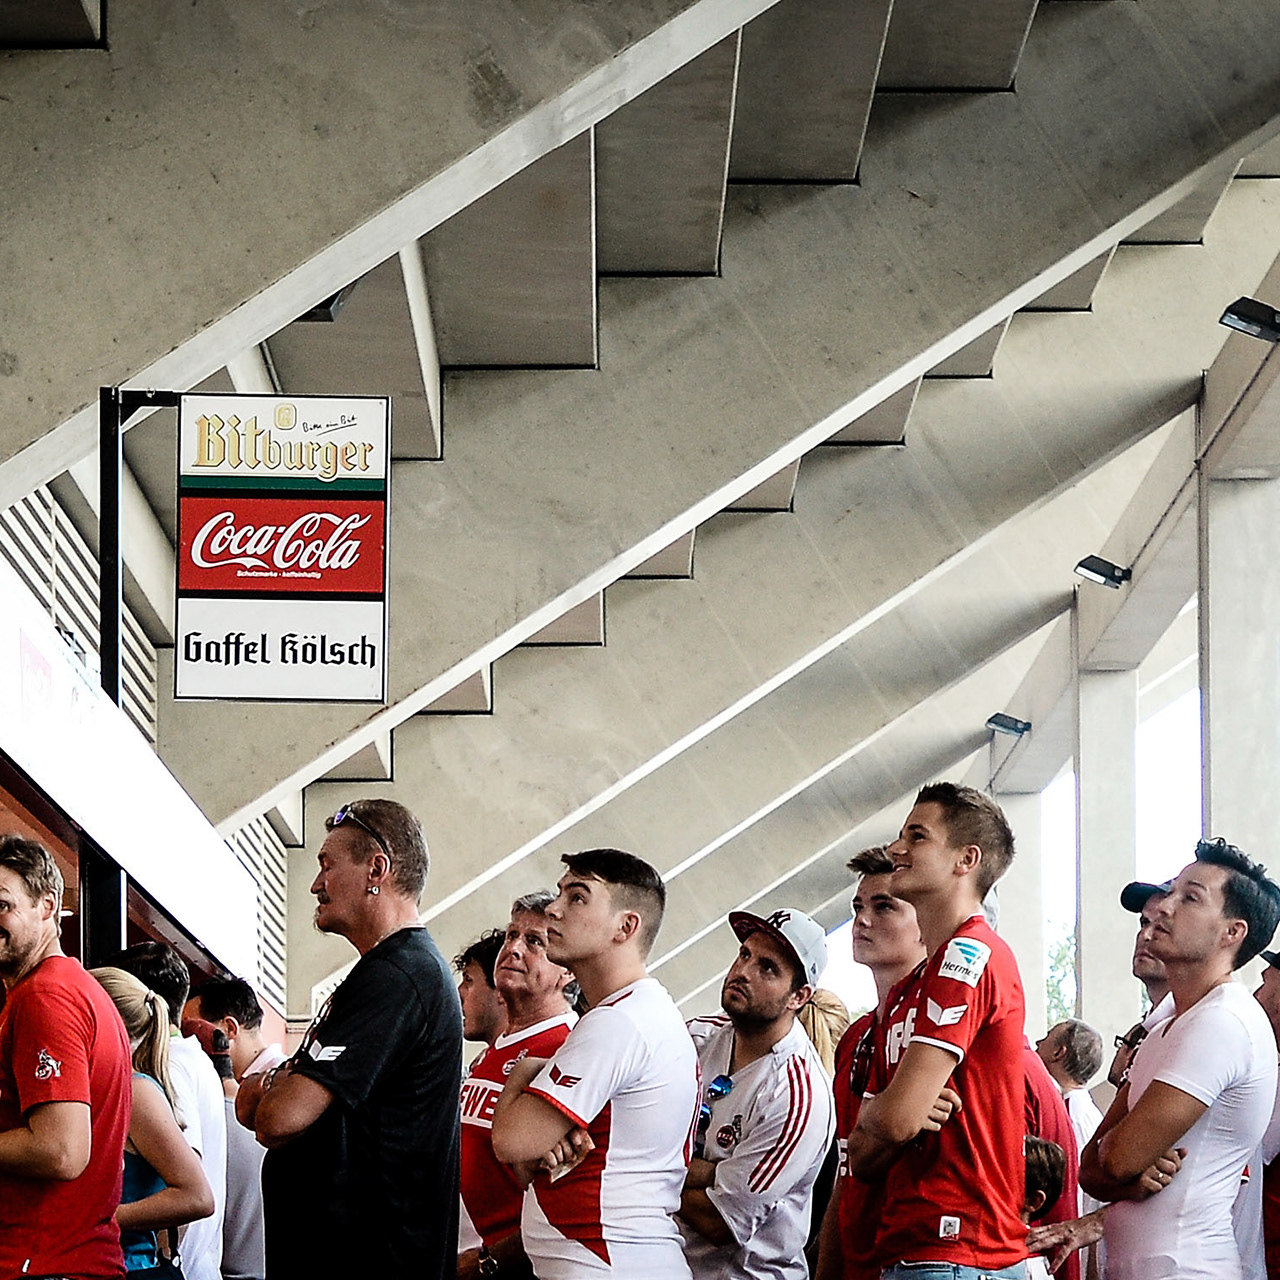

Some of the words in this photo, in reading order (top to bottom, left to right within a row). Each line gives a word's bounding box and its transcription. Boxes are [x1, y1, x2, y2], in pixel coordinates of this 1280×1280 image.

[191, 413, 374, 479] Bitburger
[191, 511, 372, 570] Coca-Cola
[184, 631, 271, 667] Gaffel
[280, 633, 377, 669] Kölsch
